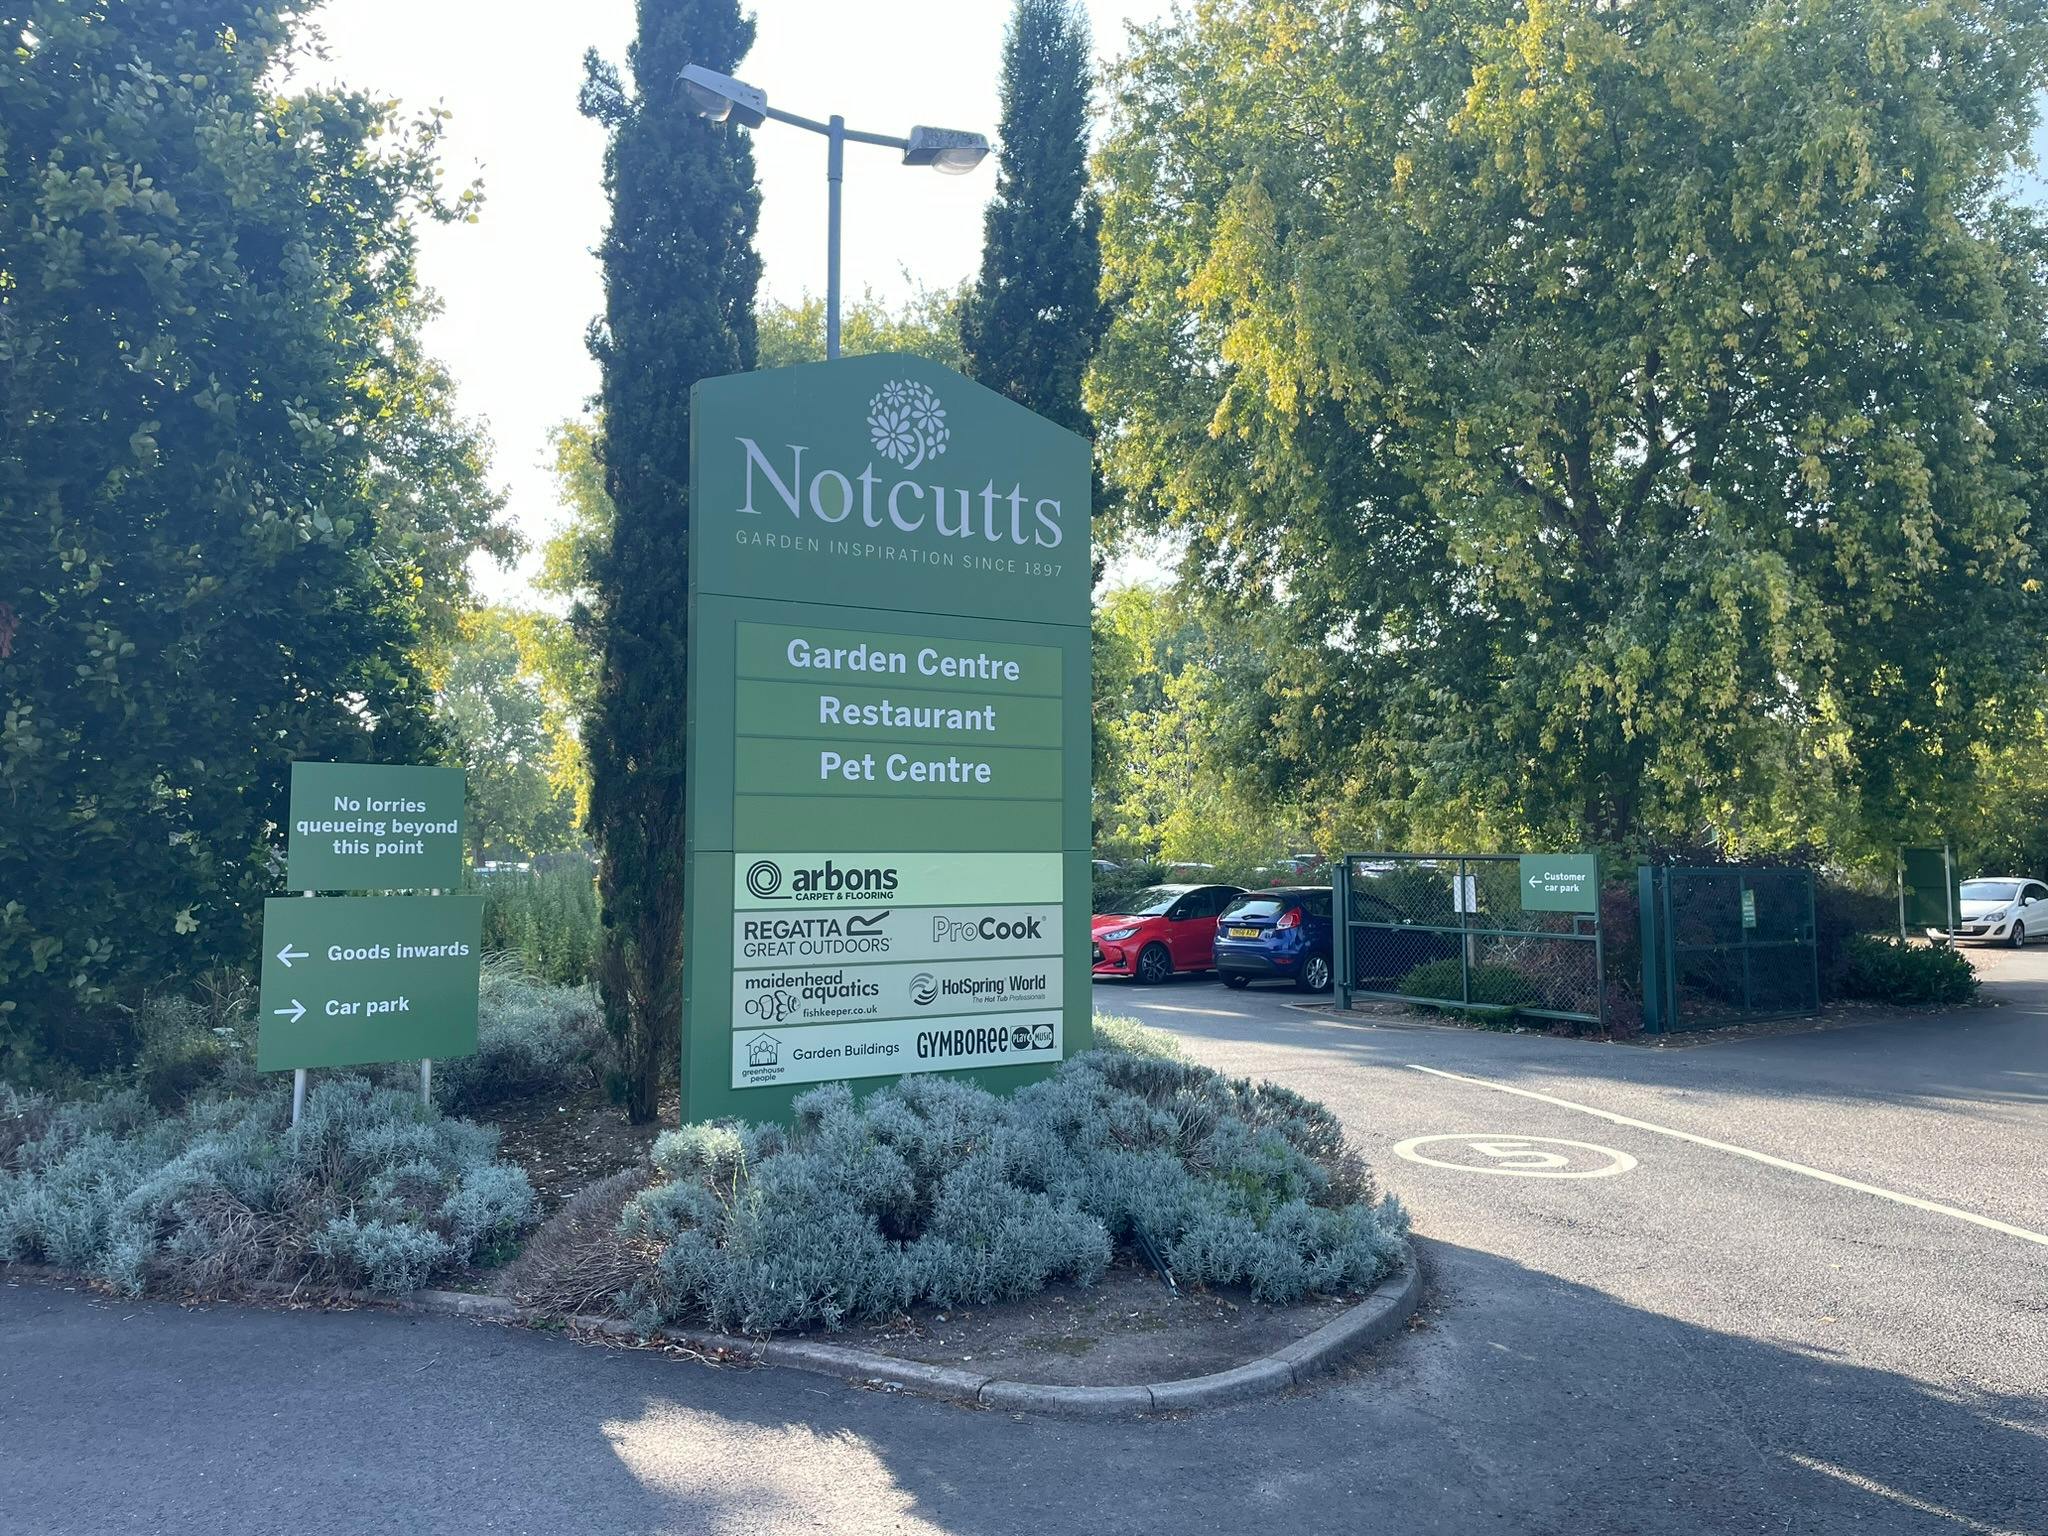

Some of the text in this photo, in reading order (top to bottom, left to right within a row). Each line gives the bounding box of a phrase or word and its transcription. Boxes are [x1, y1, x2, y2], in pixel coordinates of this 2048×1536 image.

[734, 436, 1064, 549] Notcutts
[735, 529, 1063, 578] GARDEN INSPIRATION SINCE 1897
[787, 638, 1020, 681] Garden Centre
[820, 696, 996, 731] Restaurant
[820, 752, 991, 783] Pet Centre
[334, 796, 426, 813] No lorries
[296, 818, 458, 837] queueing beyond
[333, 839, 424, 857] this point
[792, 860, 898, 891] arbons
[1544, 872, 1586, 881] Customer
[796, 891, 894, 901] CARPET & FLOORING
[1560, 884, 1580, 893] park
[744, 918, 842, 940] REGATTA
[932, 915, 1042, 943] ProCook
[327, 941, 469, 962] Goods inwards
[744, 938, 890, 958] GREAT OUTDOORS
[745, 970, 842, 989] maidenhead
[942, 974, 1046, 996] HotSpring World
[802, 979, 879, 1004] aquatics
[324, 996, 410, 1017] Car park
[802, 1004, 878, 1018] fishkeeper.co.uk
[792, 1044, 900, 1060] Garden Buildings
[742, 1067, 785, 1078] greenhouse
[750, 1074, 777, 1084] people
[1470, 1142, 1569, 1168] 5
